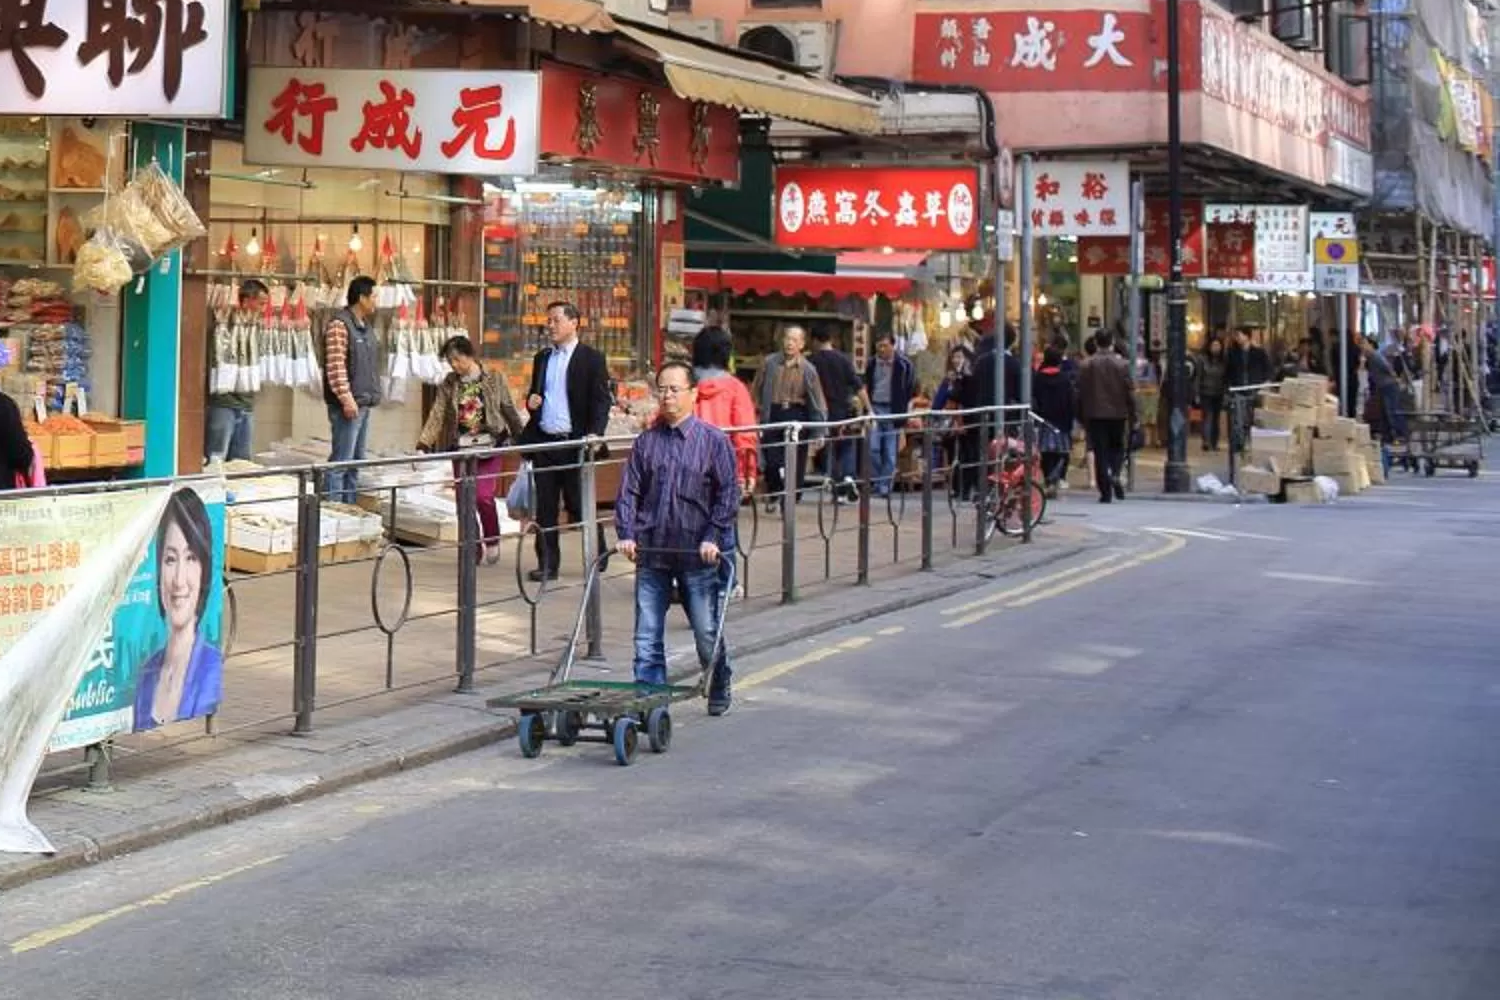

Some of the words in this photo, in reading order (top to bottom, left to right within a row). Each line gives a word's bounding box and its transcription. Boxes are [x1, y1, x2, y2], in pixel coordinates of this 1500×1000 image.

[1012, 13, 1134, 71] 大成
[265, 78, 517, 161] 元成行
[805, 189, 946, 227] 燕窩冬蟲草
